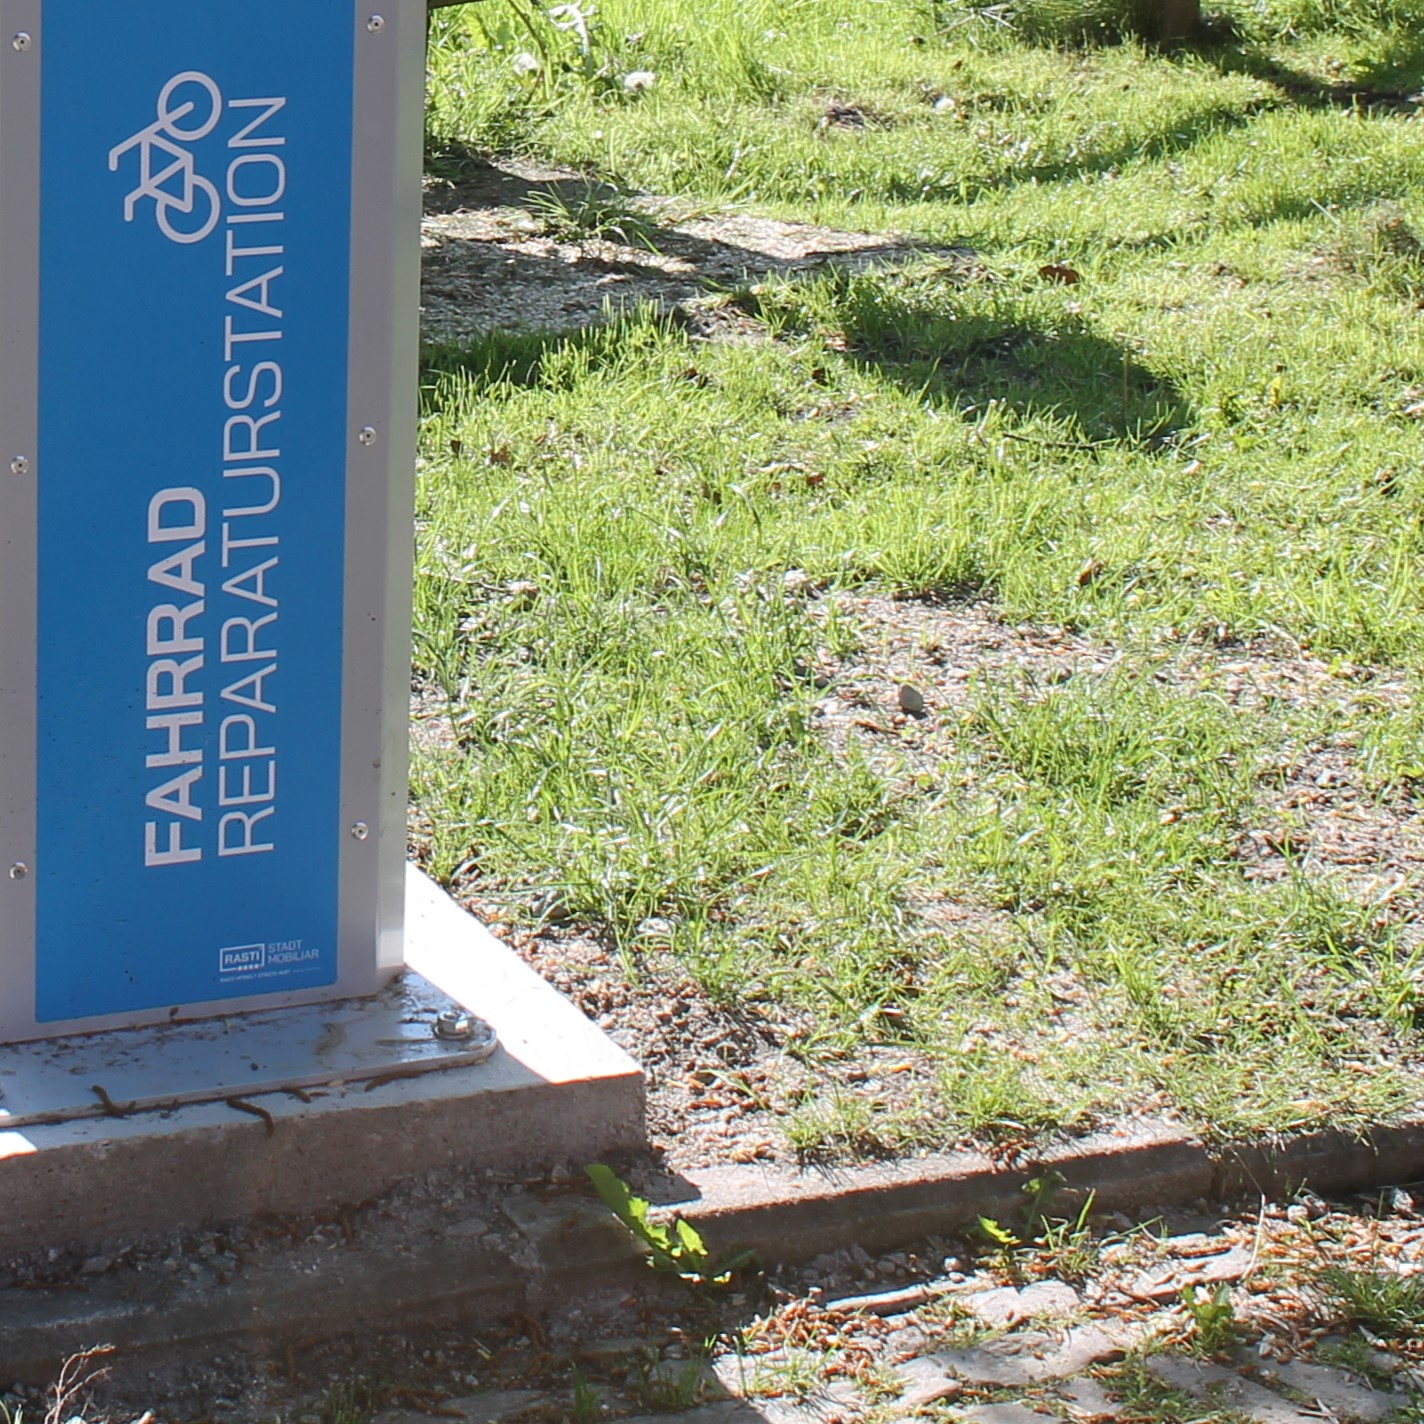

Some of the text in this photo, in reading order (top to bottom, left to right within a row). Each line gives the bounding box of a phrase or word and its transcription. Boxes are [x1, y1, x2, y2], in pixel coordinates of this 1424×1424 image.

[218, 97, 286, 857] REPARATURSTATION
[144, 486, 207, 867] FAHRRAD
[268, 939, 302, 953] STADT
[225, 951, 260, 965] RASTI
[268, 949, 319, 965] MOBILIAR
